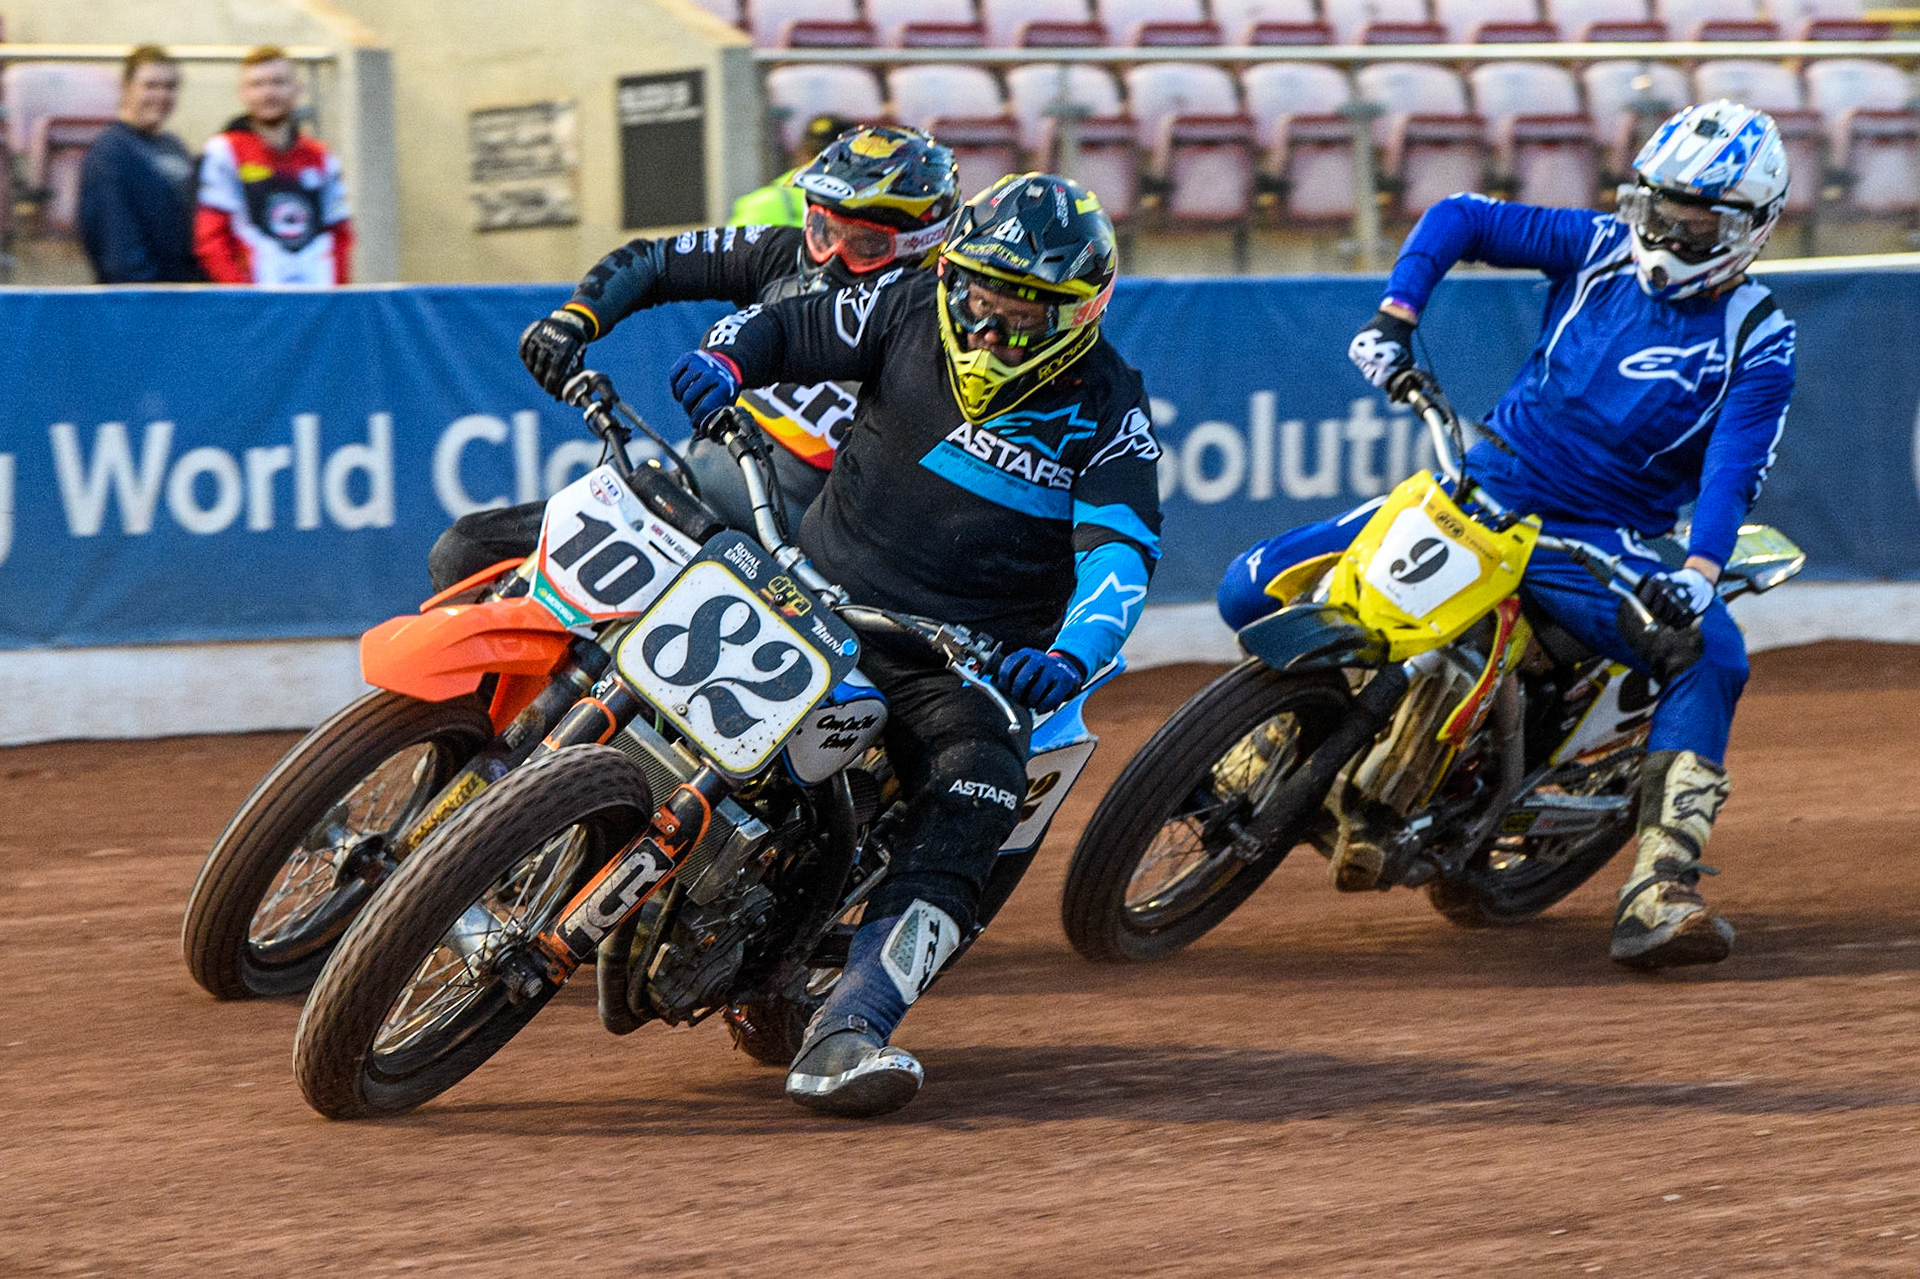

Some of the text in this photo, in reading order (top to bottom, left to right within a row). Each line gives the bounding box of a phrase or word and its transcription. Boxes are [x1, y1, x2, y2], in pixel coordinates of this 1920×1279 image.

[49, 412, 394, 537] World
[944, 421, 1075, 490] ASTARS
[549, 511, 656, 607] 10
[724, 548, 758, 580] ENFIELD
[733, 541, 762, 570] ROYAL
[1390, 537, 1449, 584] 9
[642, 595, 813, 739] 82
[948, 779, 1018, 811] ASTARS
[1020, 771, 1062, 823] 2
